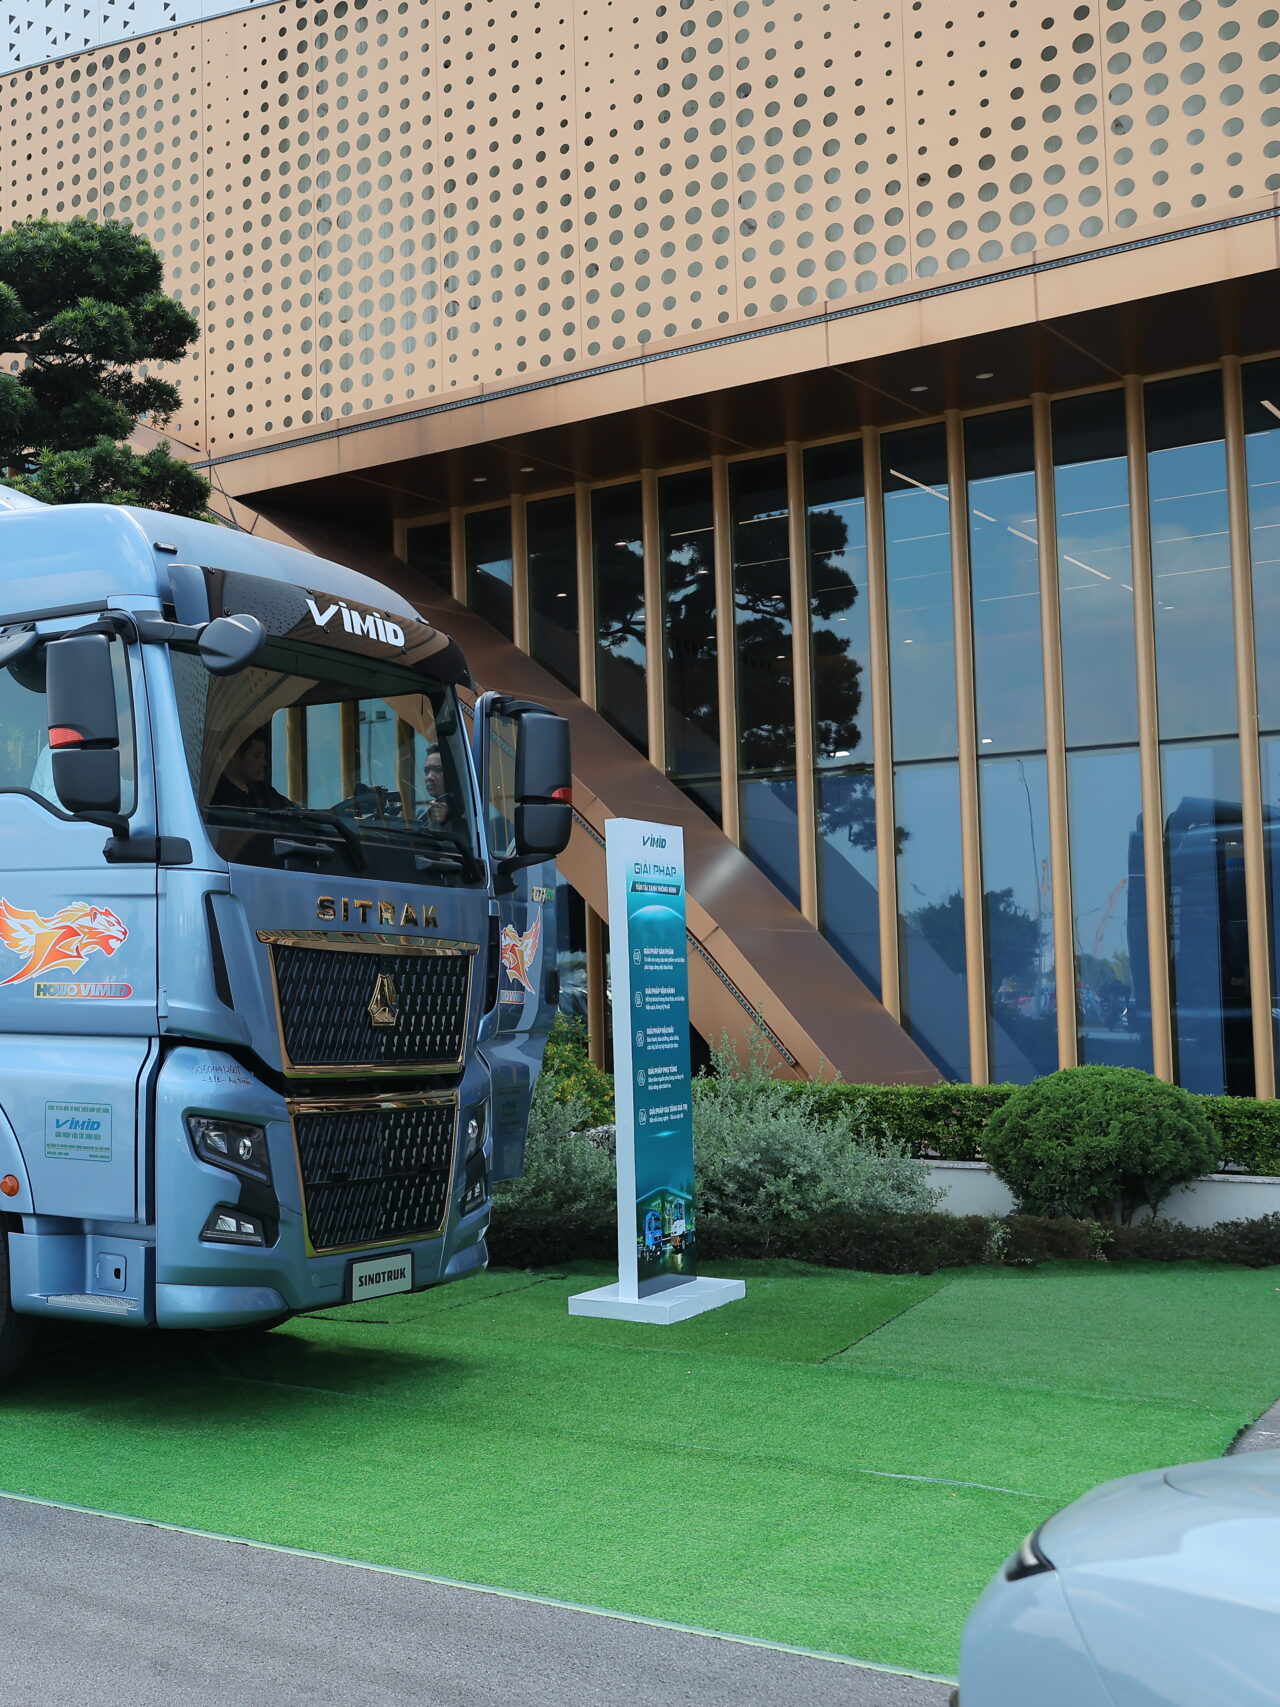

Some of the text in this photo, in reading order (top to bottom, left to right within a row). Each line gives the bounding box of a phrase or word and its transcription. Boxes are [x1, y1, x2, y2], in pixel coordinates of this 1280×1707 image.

[316, 896, 439, 928] SITRAK
[36, 983, 129, 997] HOWO VIMID
[358, 1267, 407, 1288] SINOTRUK
